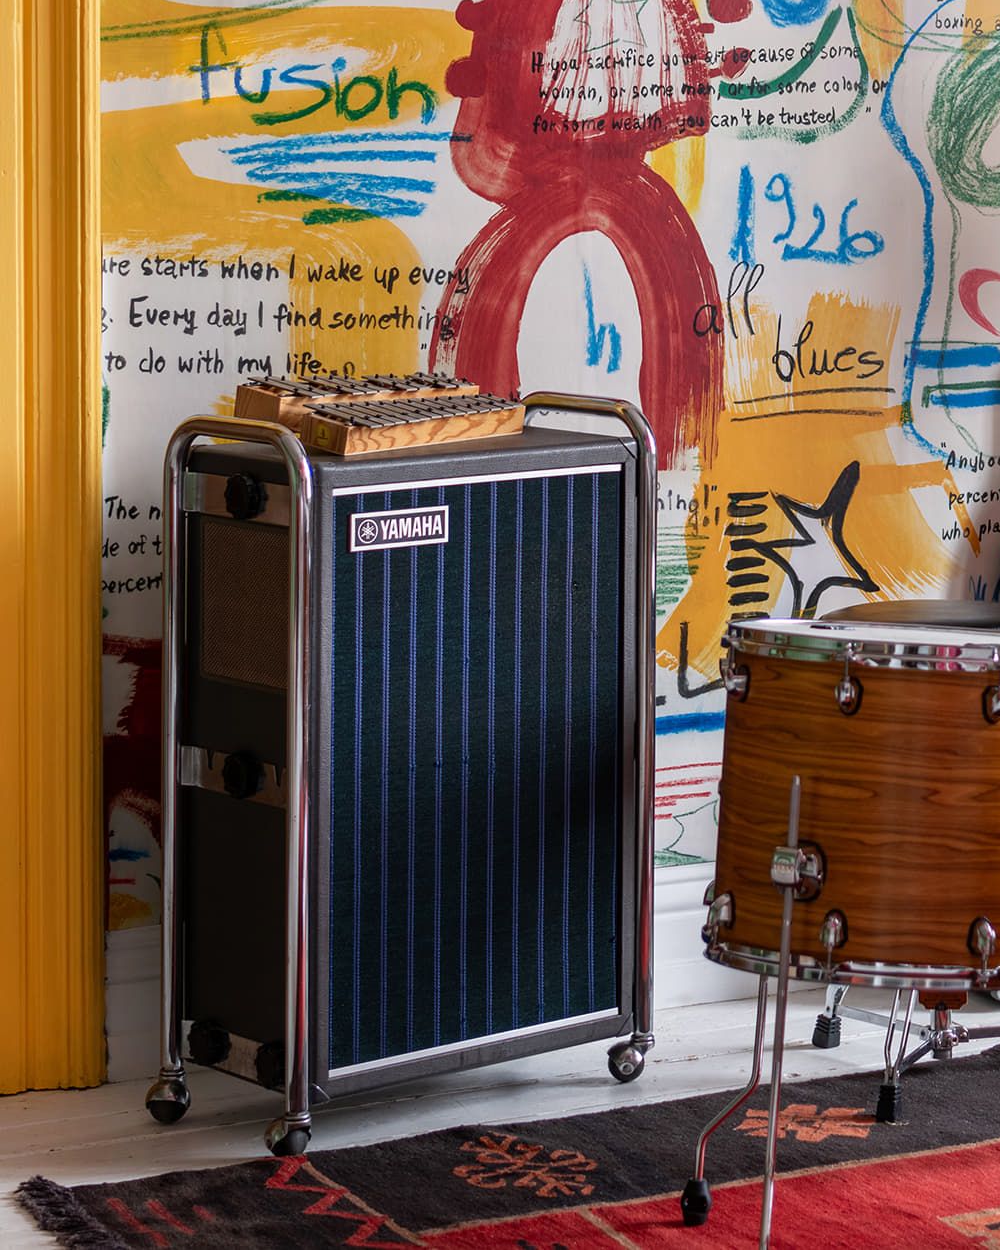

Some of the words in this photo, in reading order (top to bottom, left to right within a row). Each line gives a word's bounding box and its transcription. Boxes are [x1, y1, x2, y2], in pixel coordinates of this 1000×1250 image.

[935, 10, 984, 36] boxing
[586, 48, 655, 70] sacrifice
[732, 45, 795, 64] because
[820, 44, 861, 61] some
[632, 82, 674, 99] some
[777, 79, 817, 95] some
[710, 107, 752, 128] can't
[757, 107, 775, 126] be
[728, 164, 886, 267] 1926
[141, 253, 209, 280] starts
[219, 253, 280, 280] when
[307, 257, 365, 283] wake
[373, 265, 401, 294] up
[408, 264, 472, 296] every
[128, 295, 199, 336] Every
[207, 302, 248, 337] day
[273, 301, 324, 333] find
[328, 305, 457, 342] something
[692, 260, 766, 339] all
[771, 313, 888, 383] blues
[105, 353, 128, 372] to
[139, 346, 166, 375] do
[178, 351, 225, 375] with
[238, 352, 274, 378] my
[104, 496, 141, 521] The
[380, 514, 443, 541] YAMAHA
[941, 521, 971, 542] who
[128, 540, 150, 556] of
